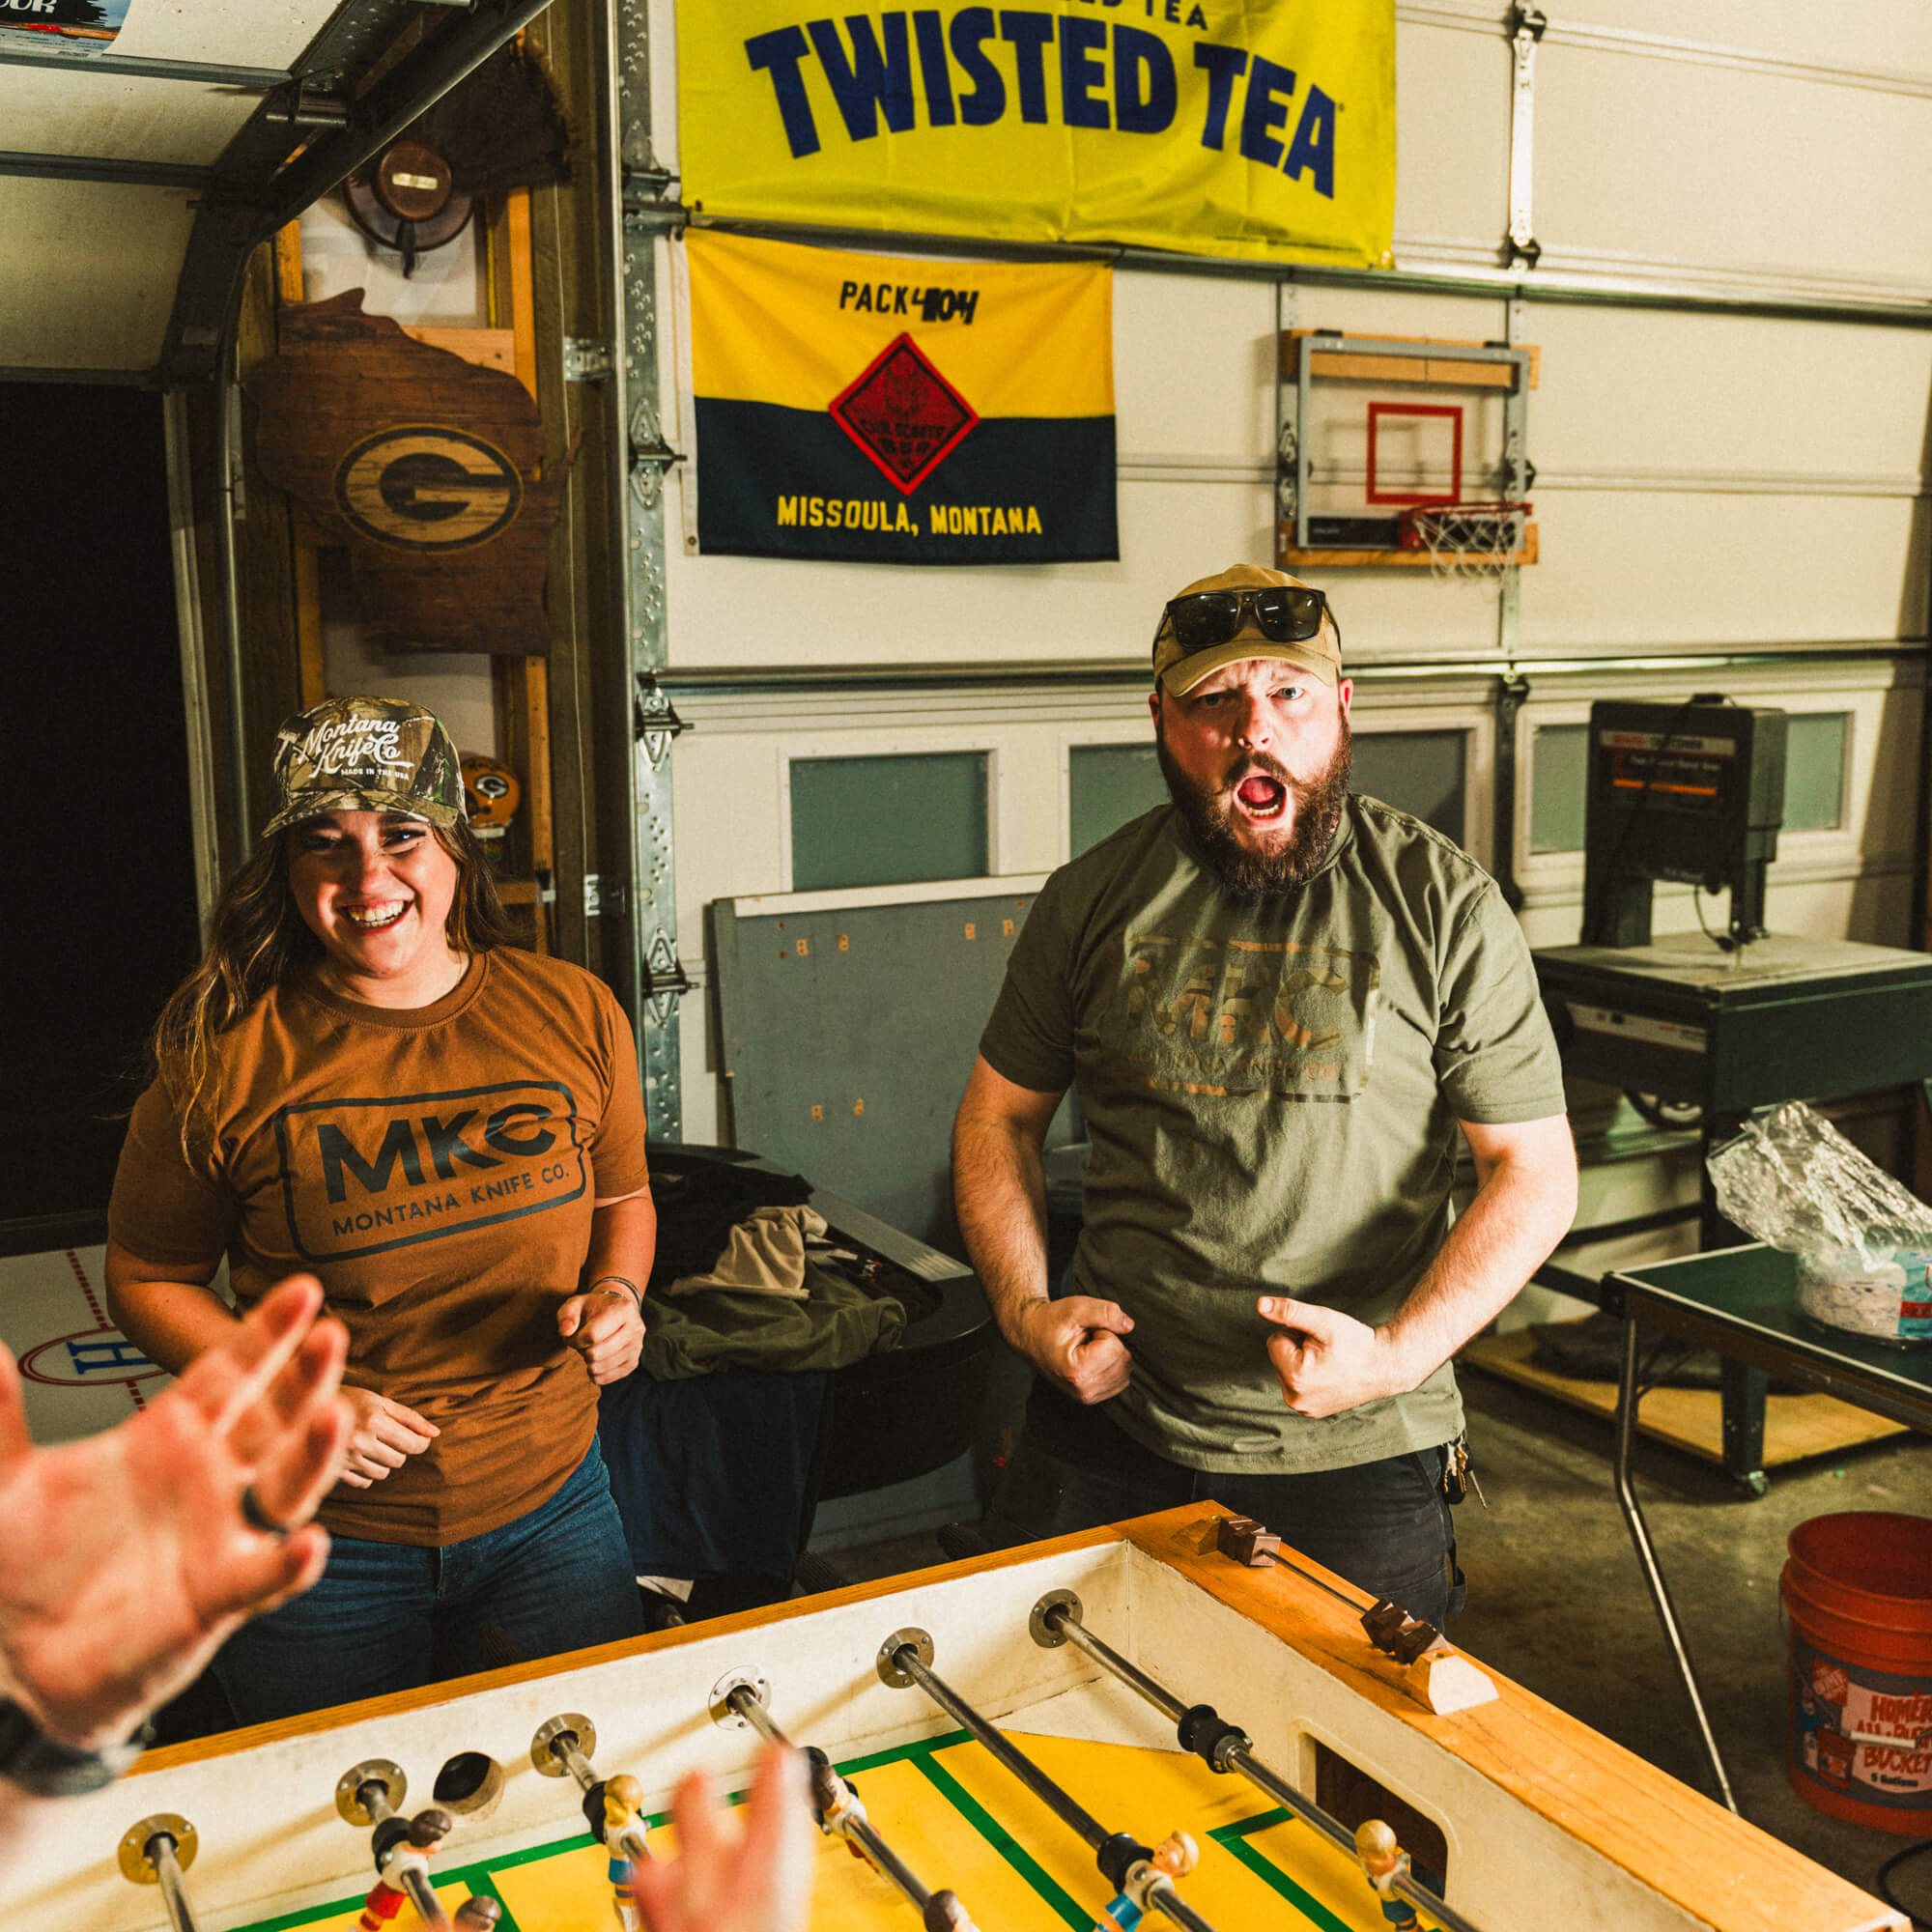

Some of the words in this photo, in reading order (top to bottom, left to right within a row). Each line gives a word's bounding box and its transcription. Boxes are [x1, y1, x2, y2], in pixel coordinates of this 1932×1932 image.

[744, 7, 1178, 159] TWISTED
[1193, 41, 1336, 200] TEA
[839, 280, 909, 315] PACK
[778, 495, 919, 537] MISSOULA,
[930, 504, 1043, 536] MONTANA
[298, 713, 401, 765] Montana
[309, 734, 377, 779] Knife
[317, 1103, 557, 1206] MKC
[331, 1193, 461, 1237] MONTANA
[470, 1172, 535, 1204] KNIFE
[541, 1163, 570, 1183] CO.
